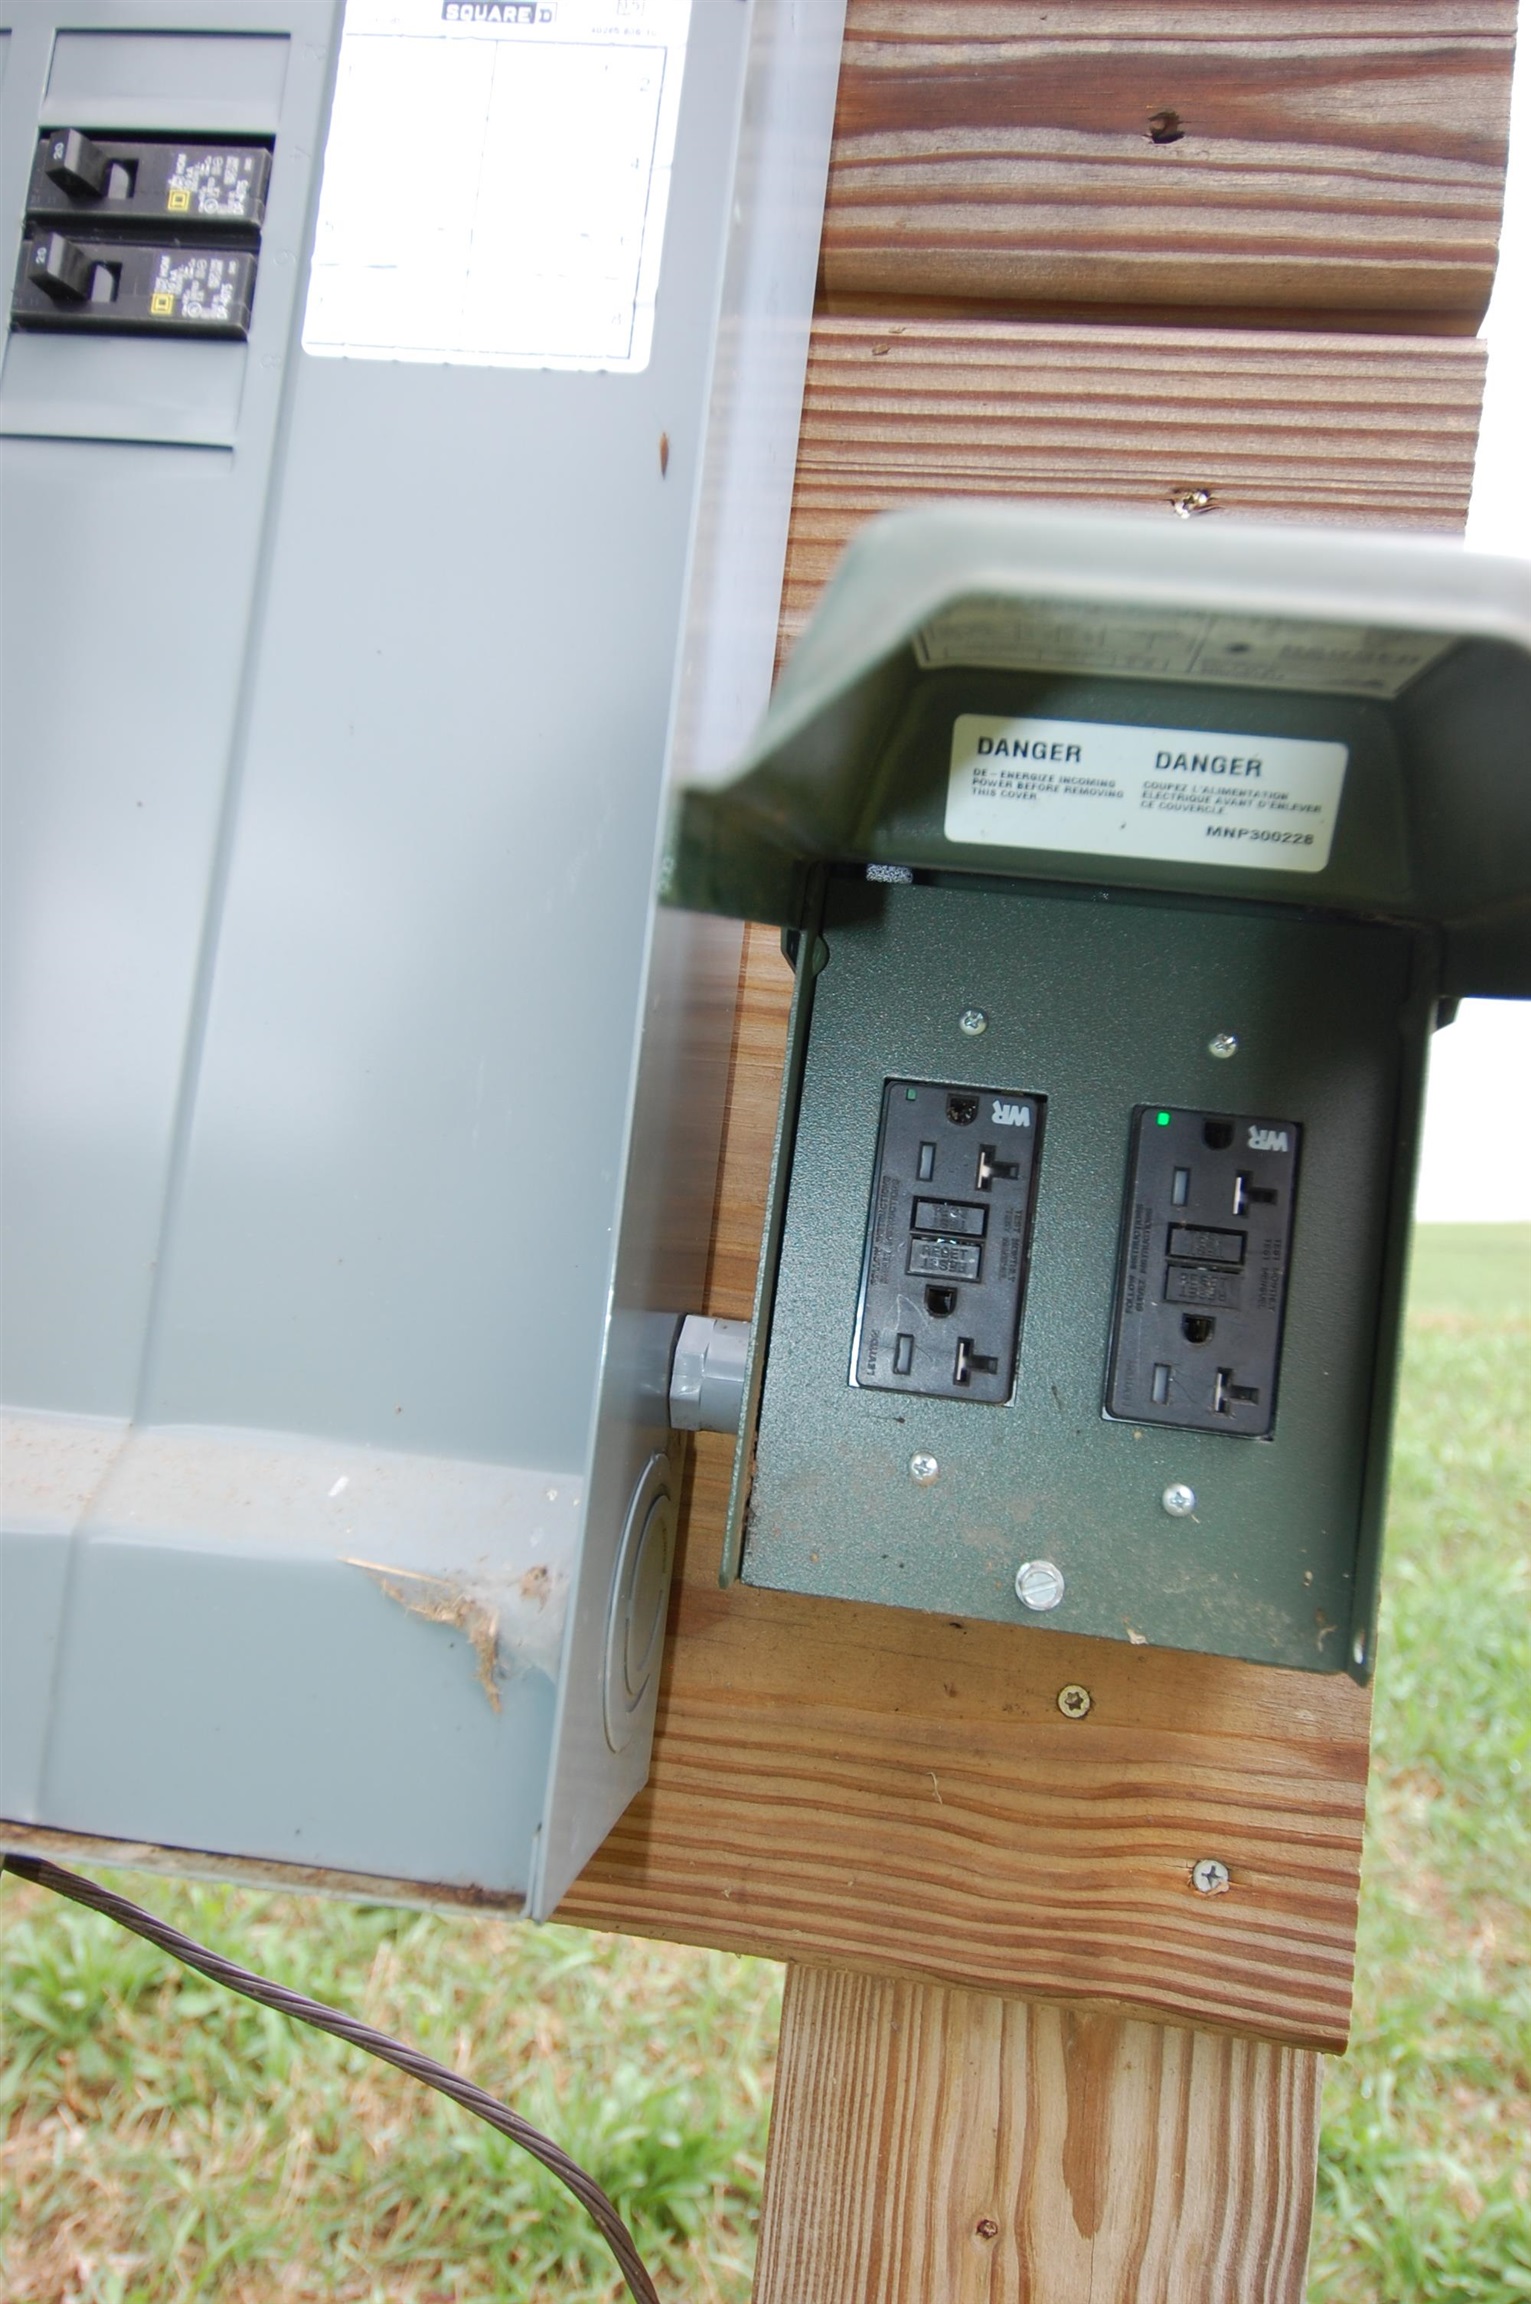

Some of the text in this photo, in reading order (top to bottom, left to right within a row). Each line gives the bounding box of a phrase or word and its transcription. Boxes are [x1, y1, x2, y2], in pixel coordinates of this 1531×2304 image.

[444, 3, 556, 22] SQUARE D
[52, 141, 64, 160] 20
[35, 246, 47, 265] 20
[160, 255, 170, 277] HOM
[977, 735, 1082, 763] DANGER
[1155, 750, 1263, 777] DANGER
[972, 778, 1125, 799] POWER BEFORE REMOVING
[1059, 775, 1116, 788] INCOMING
[1142, 780, 1289, 801] COUPEZ L'ALIMENTATION
[971, 787, 1037, 800] THIS COVER
[1140, 800, 1224, 815] CE COUVERCLE
[1215, 796, 1253, 808] AVANT
[1258, 800, 1322, 814] D'ENLEVER
[1205, 825, 1315, 846] MNP300228
[991, 1100, 1031, 1128] WR
[1247, 1125, 1289, 1153] WR
[1140, 1207, 1153, 1274] INSTRUCTIONS
[920, 1244, 969, 1260] RESET
[1125, 1203, 1144, 1314] FOLLOW INSTRUCTIONS
[918, 1257, 968, 1273] RESET
[1257, 1239, 1272, 1311] TEST MENSUEL
[1268, 1239, 1282, 1313] TEST MONTHLY
